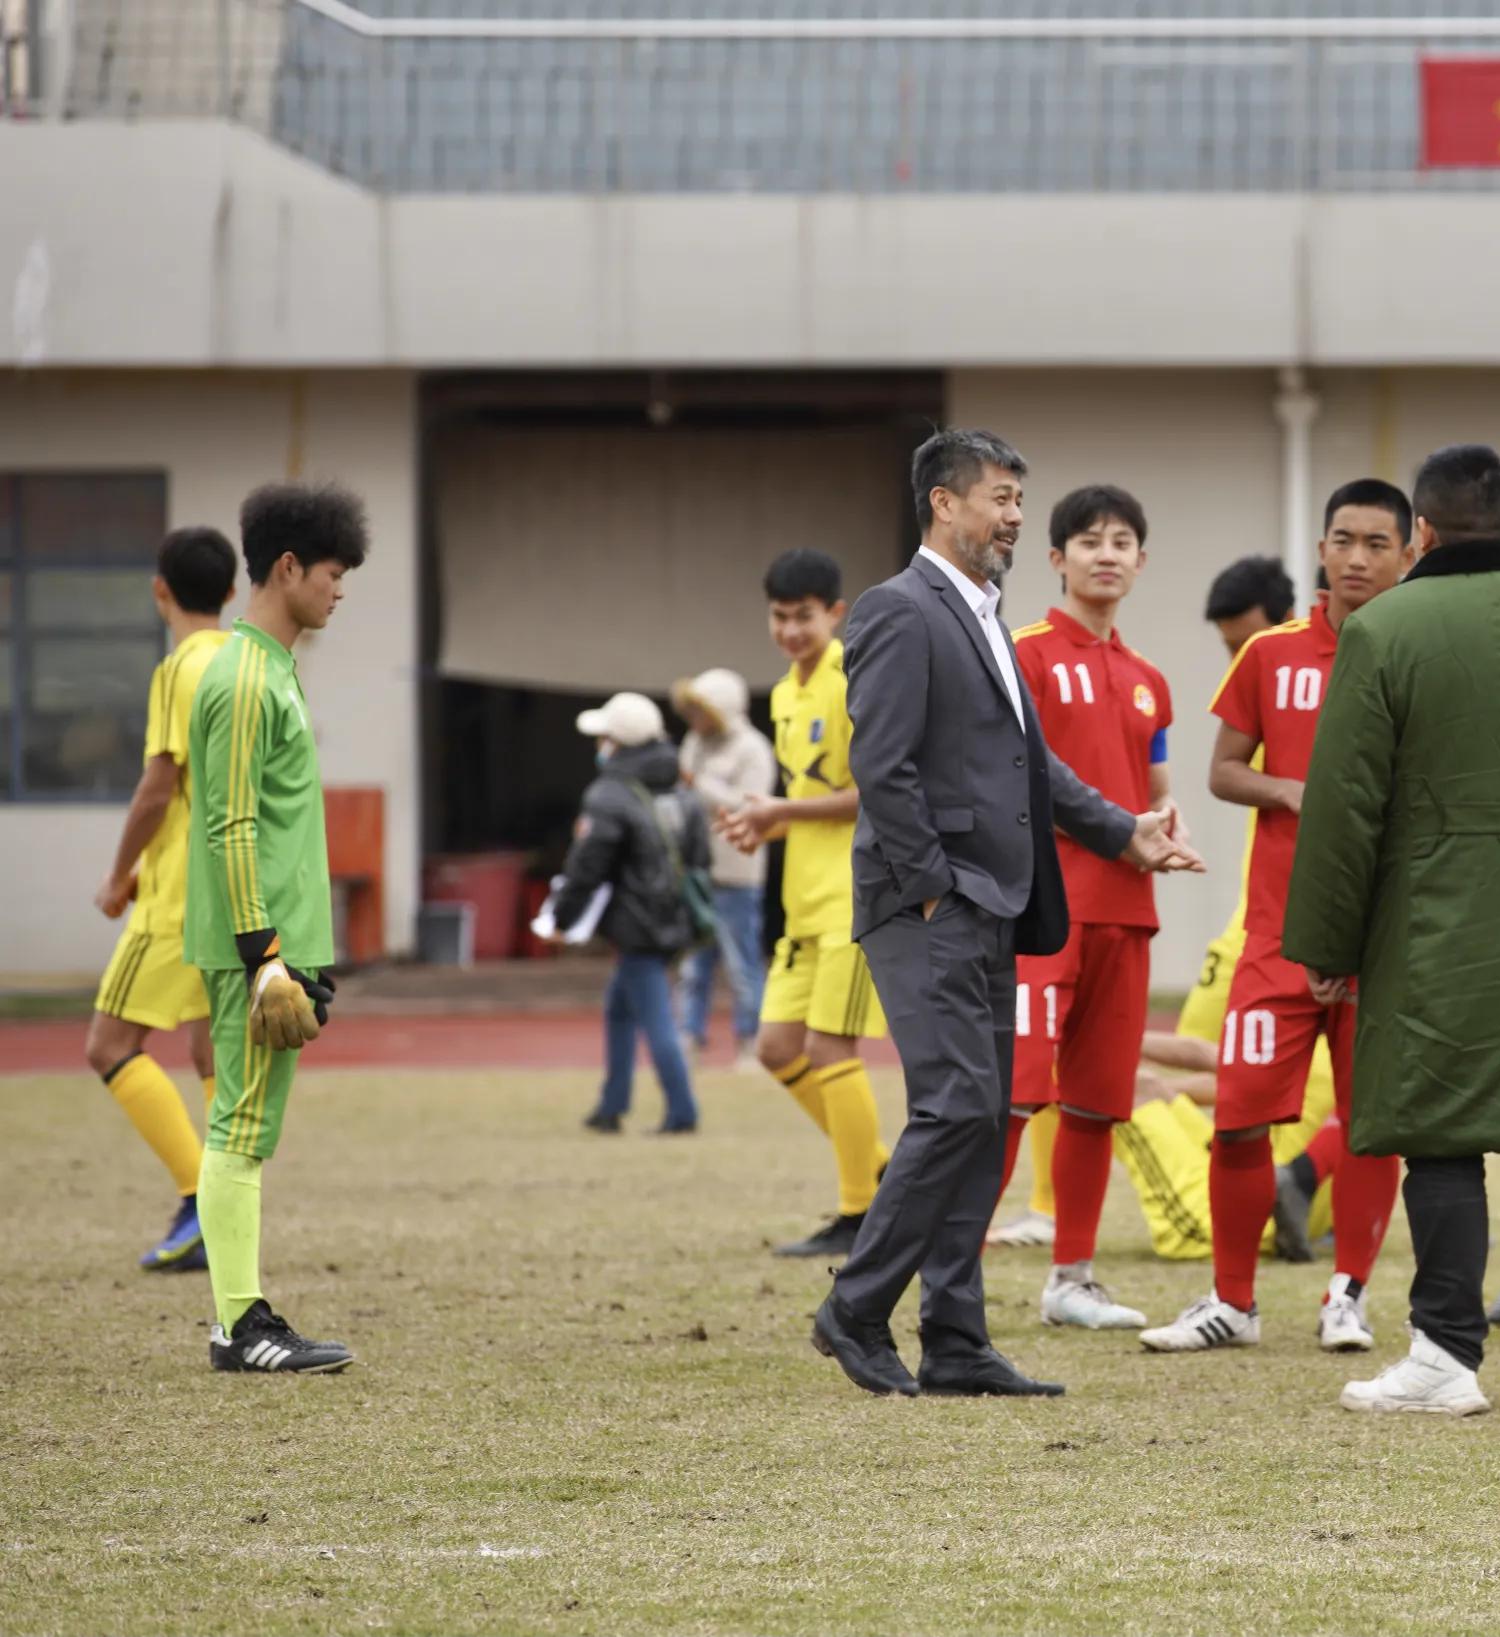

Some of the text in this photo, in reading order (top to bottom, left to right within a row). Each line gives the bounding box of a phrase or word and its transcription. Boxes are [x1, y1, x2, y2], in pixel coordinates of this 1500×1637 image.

[1052, 663, 1095, 704] 11
[1276, 667, 1323, 710] 10
[1016, 983, 1056, 1038] 11
[1223, 1010, 1275, 1065] 10
